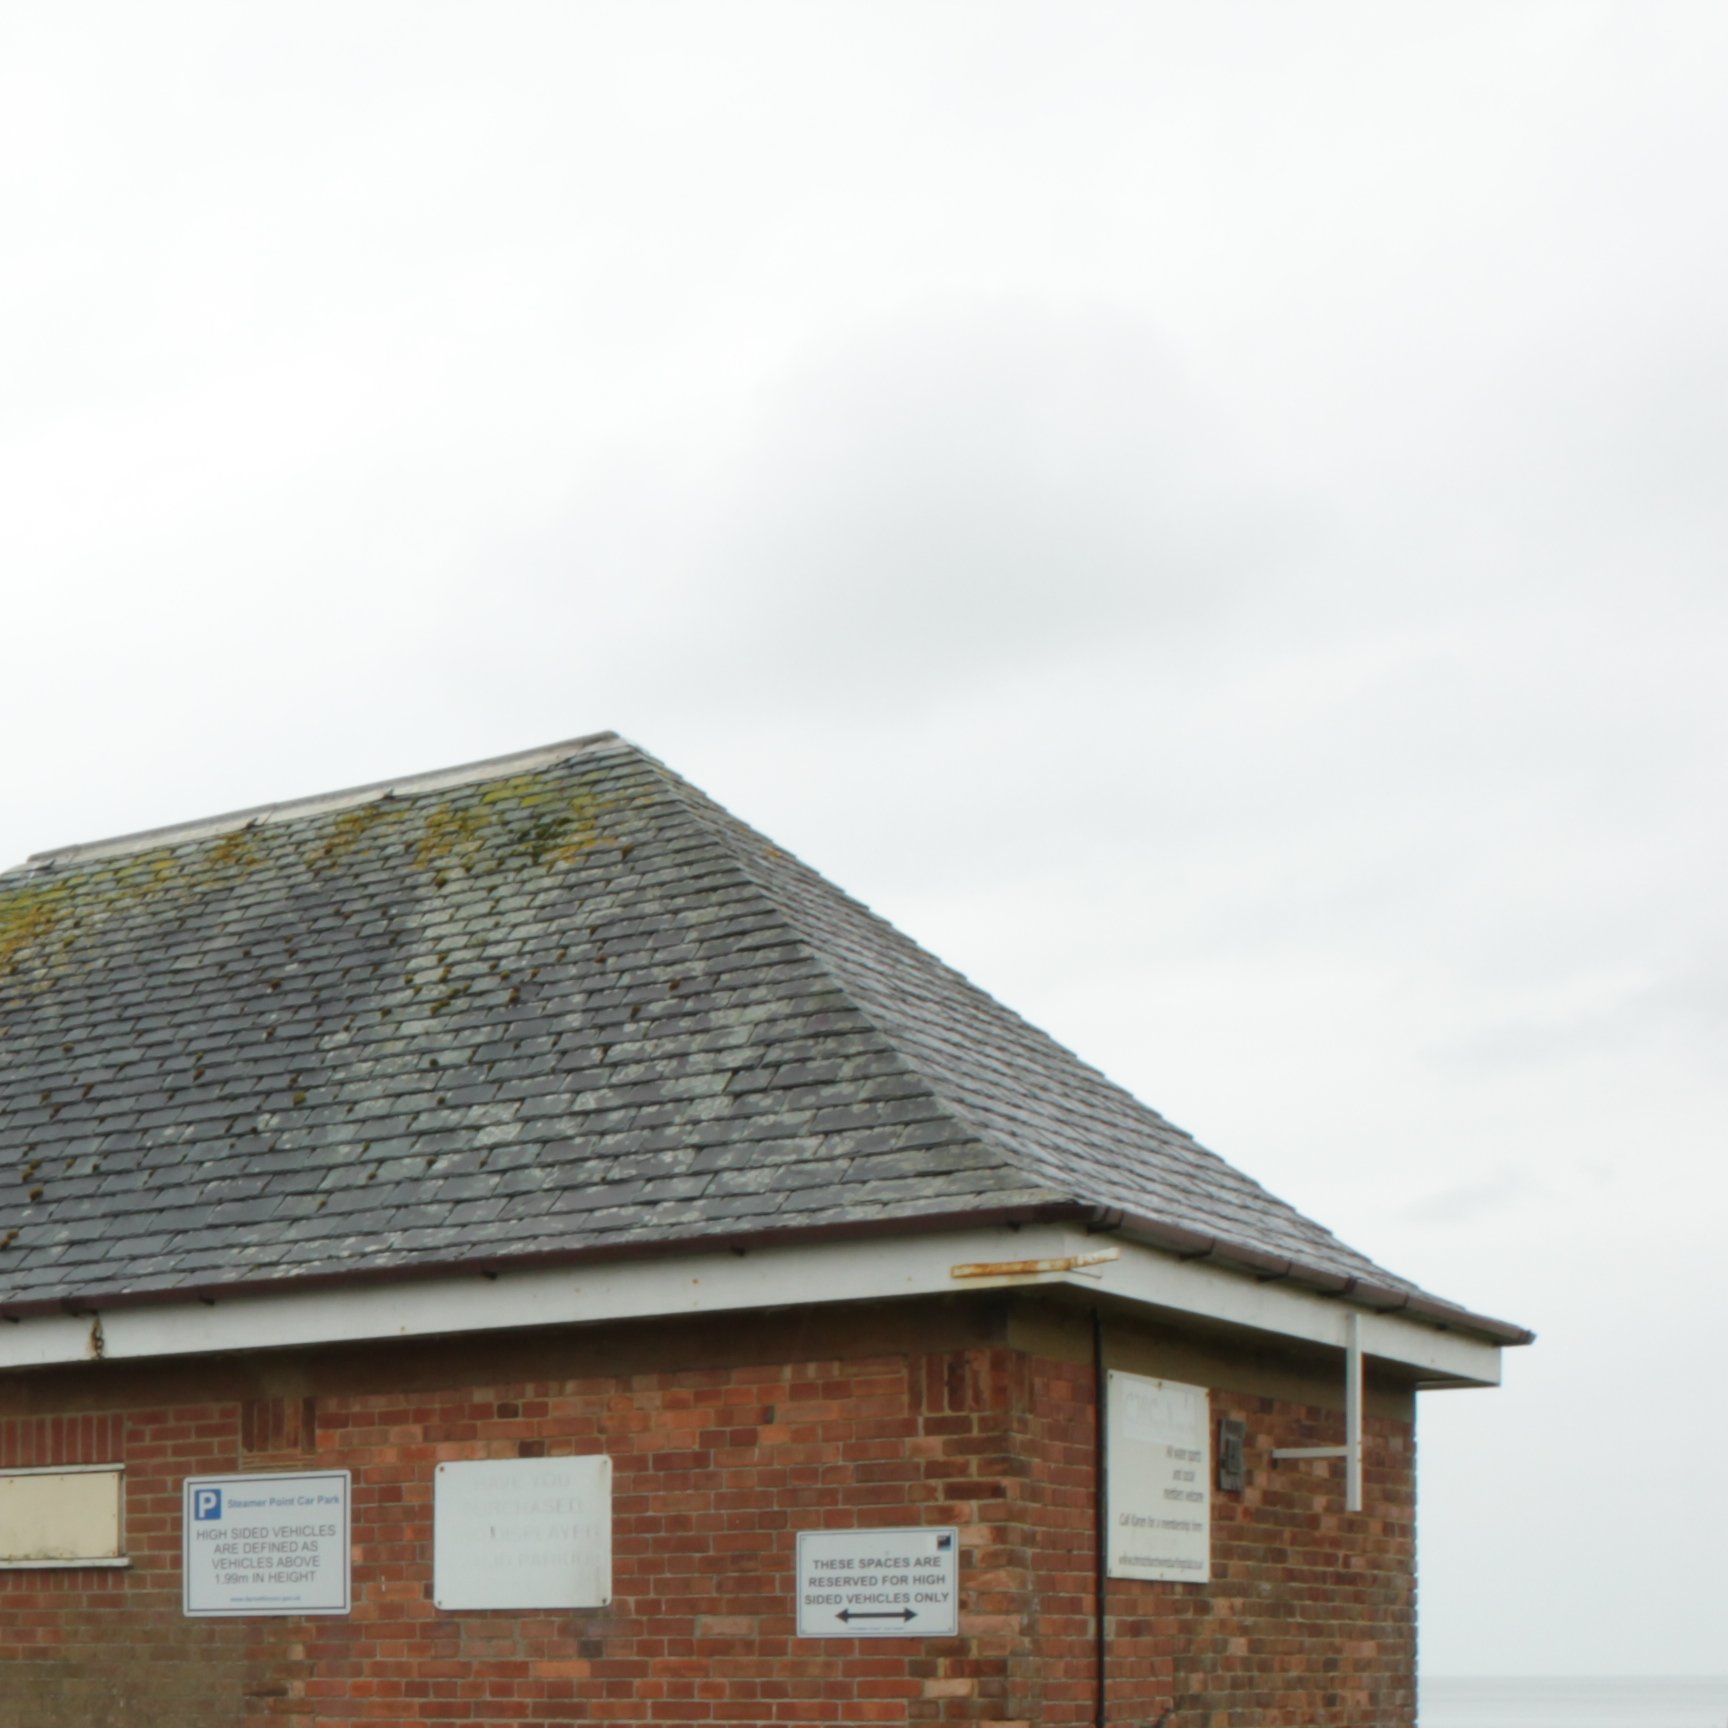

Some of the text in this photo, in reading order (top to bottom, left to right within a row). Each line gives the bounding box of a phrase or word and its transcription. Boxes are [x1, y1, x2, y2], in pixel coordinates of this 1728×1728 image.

[198, 1491, 217, 1518] P
[227, 1495, 340, 1509] Steamer Point Car Park
[196, 1524, 336, 1540] HIGH SIDED VEHICLES
[213, 1541, 318, 1555] ARE DEFINED AS
[211, 1555, 320, 1570] VEHICLES ABOVE
[813, 1556, 941, 1570] THESE SPACES ARE
[252, 1572, 264, 1583] IN
[268, 1570, 316, 1583] HEIGHT
[808, 1574, 946, 1588] RESERVED FOR HIGH
[804, 1592, 949, 1605] SIDED VEHICLES ONLY
